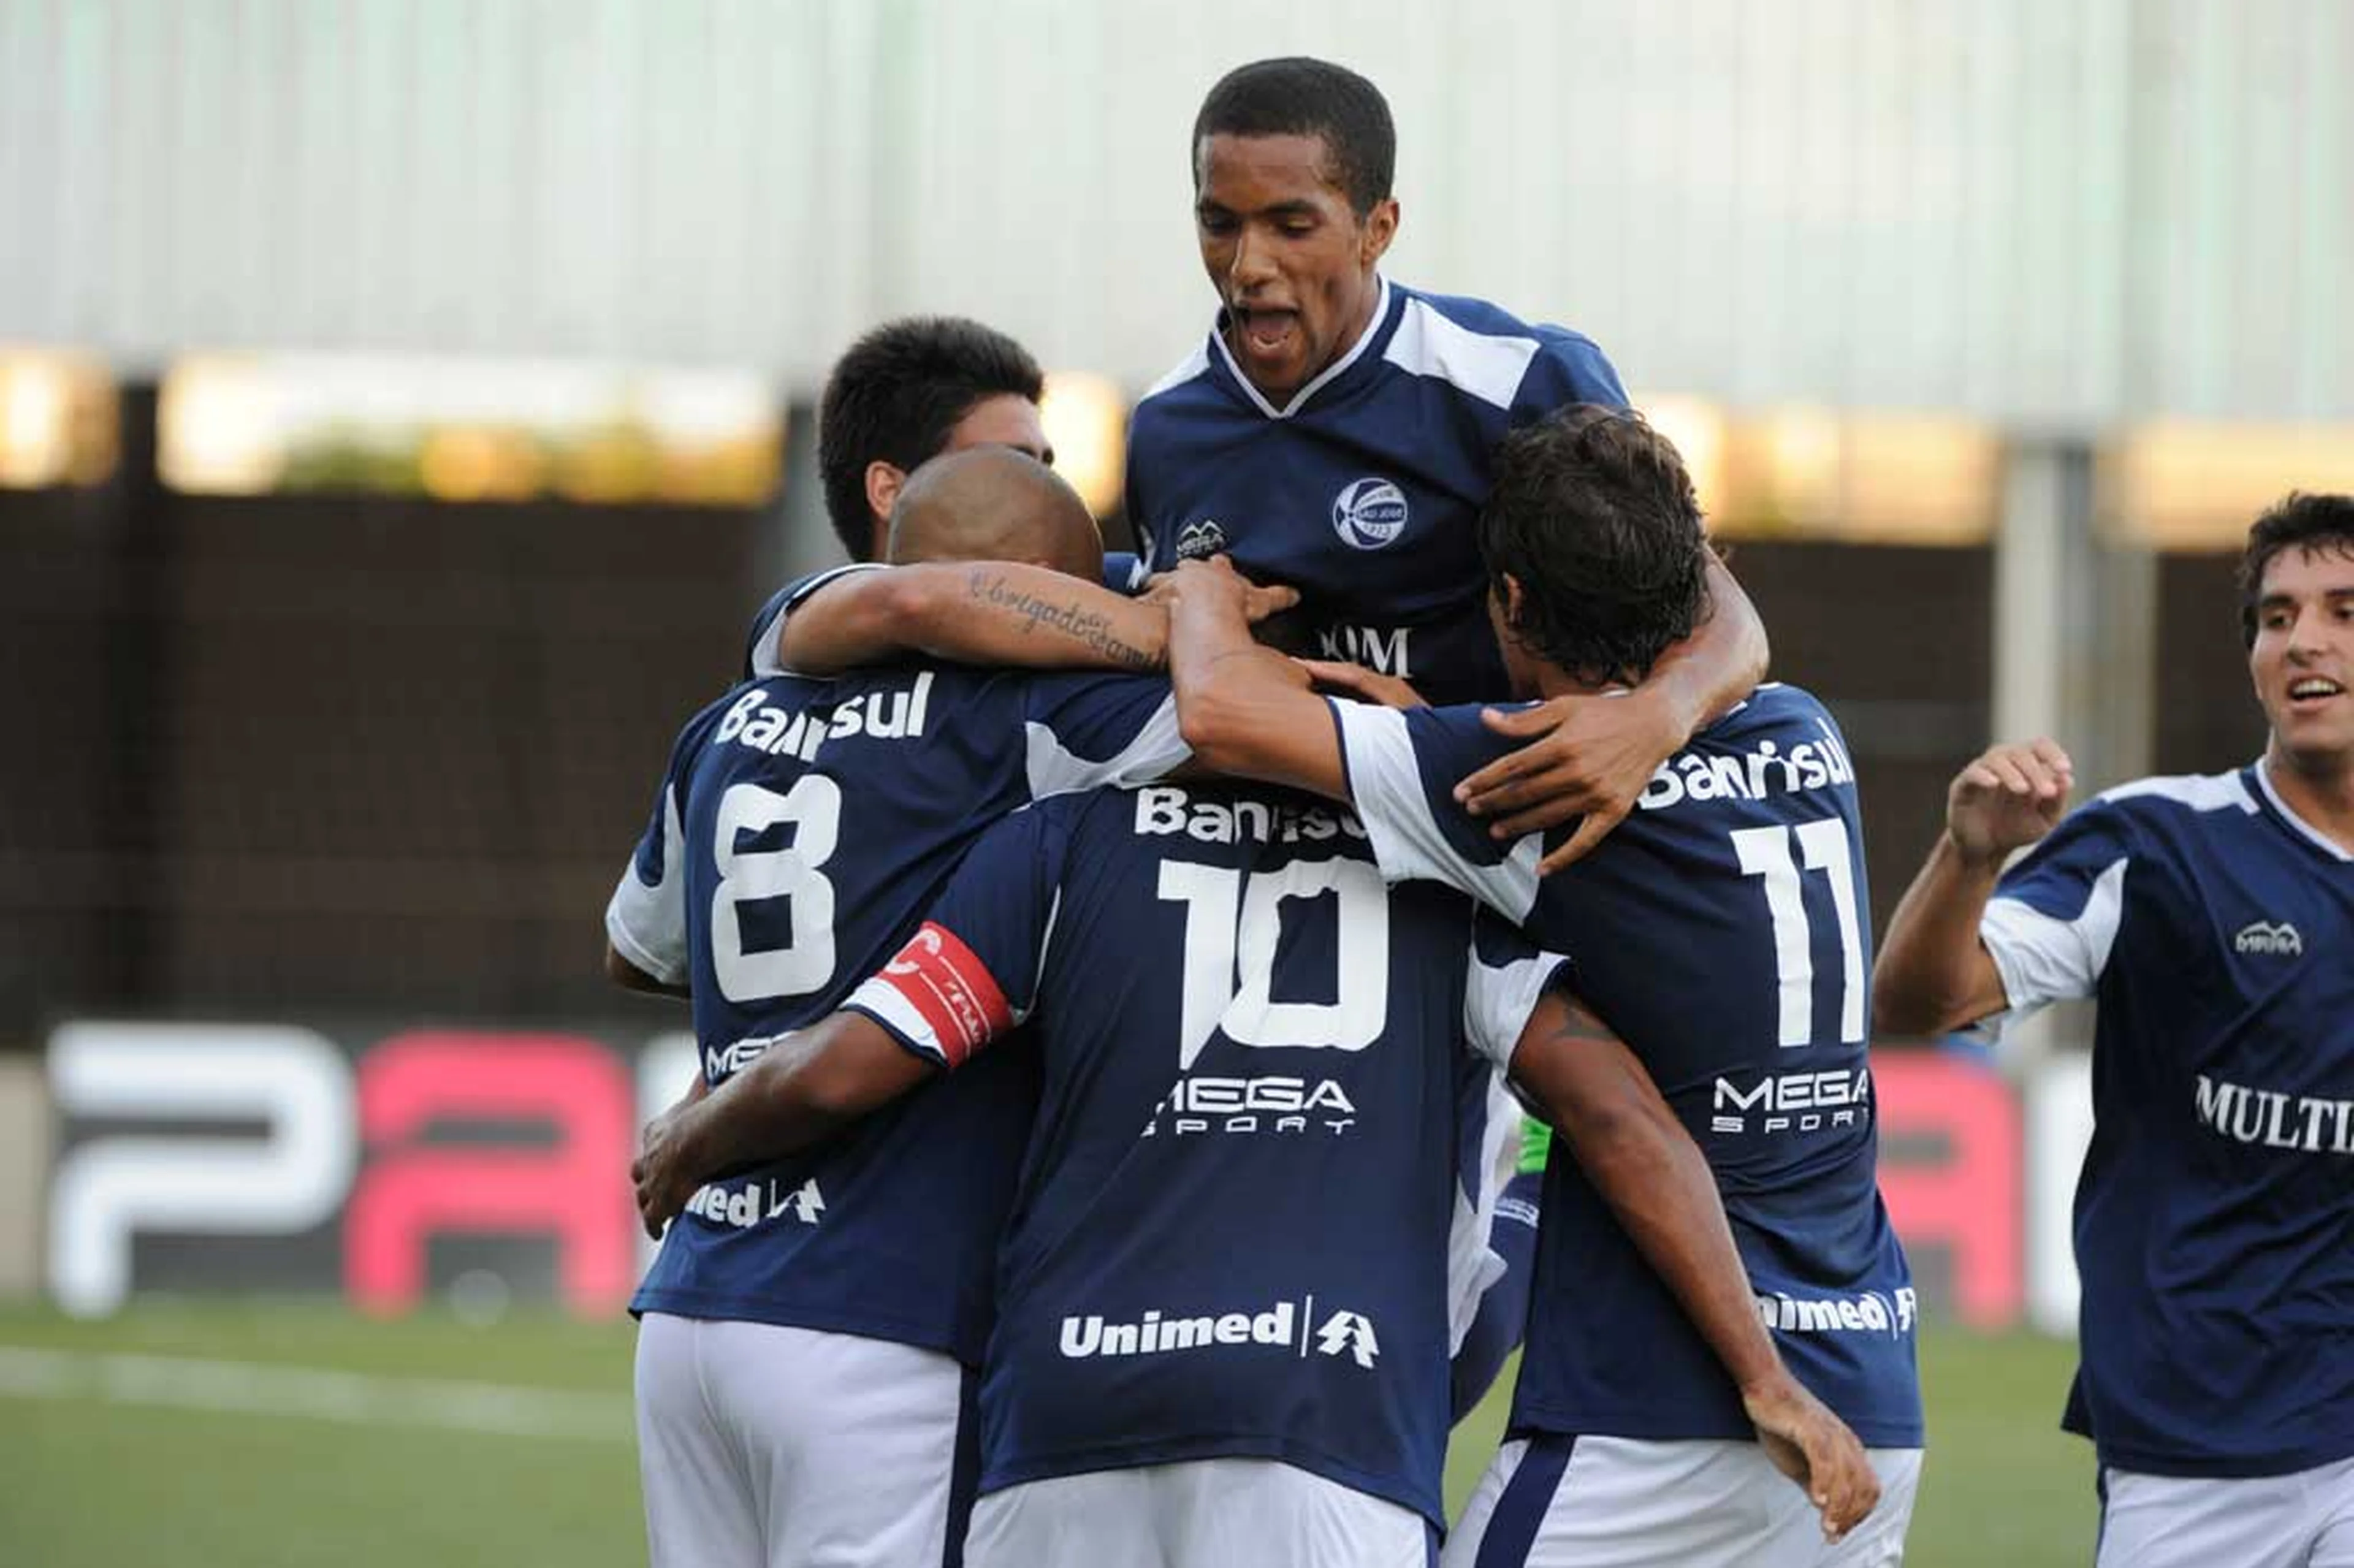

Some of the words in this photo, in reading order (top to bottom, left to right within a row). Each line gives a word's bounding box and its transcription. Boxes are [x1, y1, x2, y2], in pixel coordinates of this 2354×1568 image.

[712, 774, 842, 1003] 8
[1158, 856, 1389, 1070] 10
[1729, 817, 1865, 1046] 11
[2196, 1075, 2354, 1153] MULTI
[1060, 1301, 1295, 1358] Unimed
